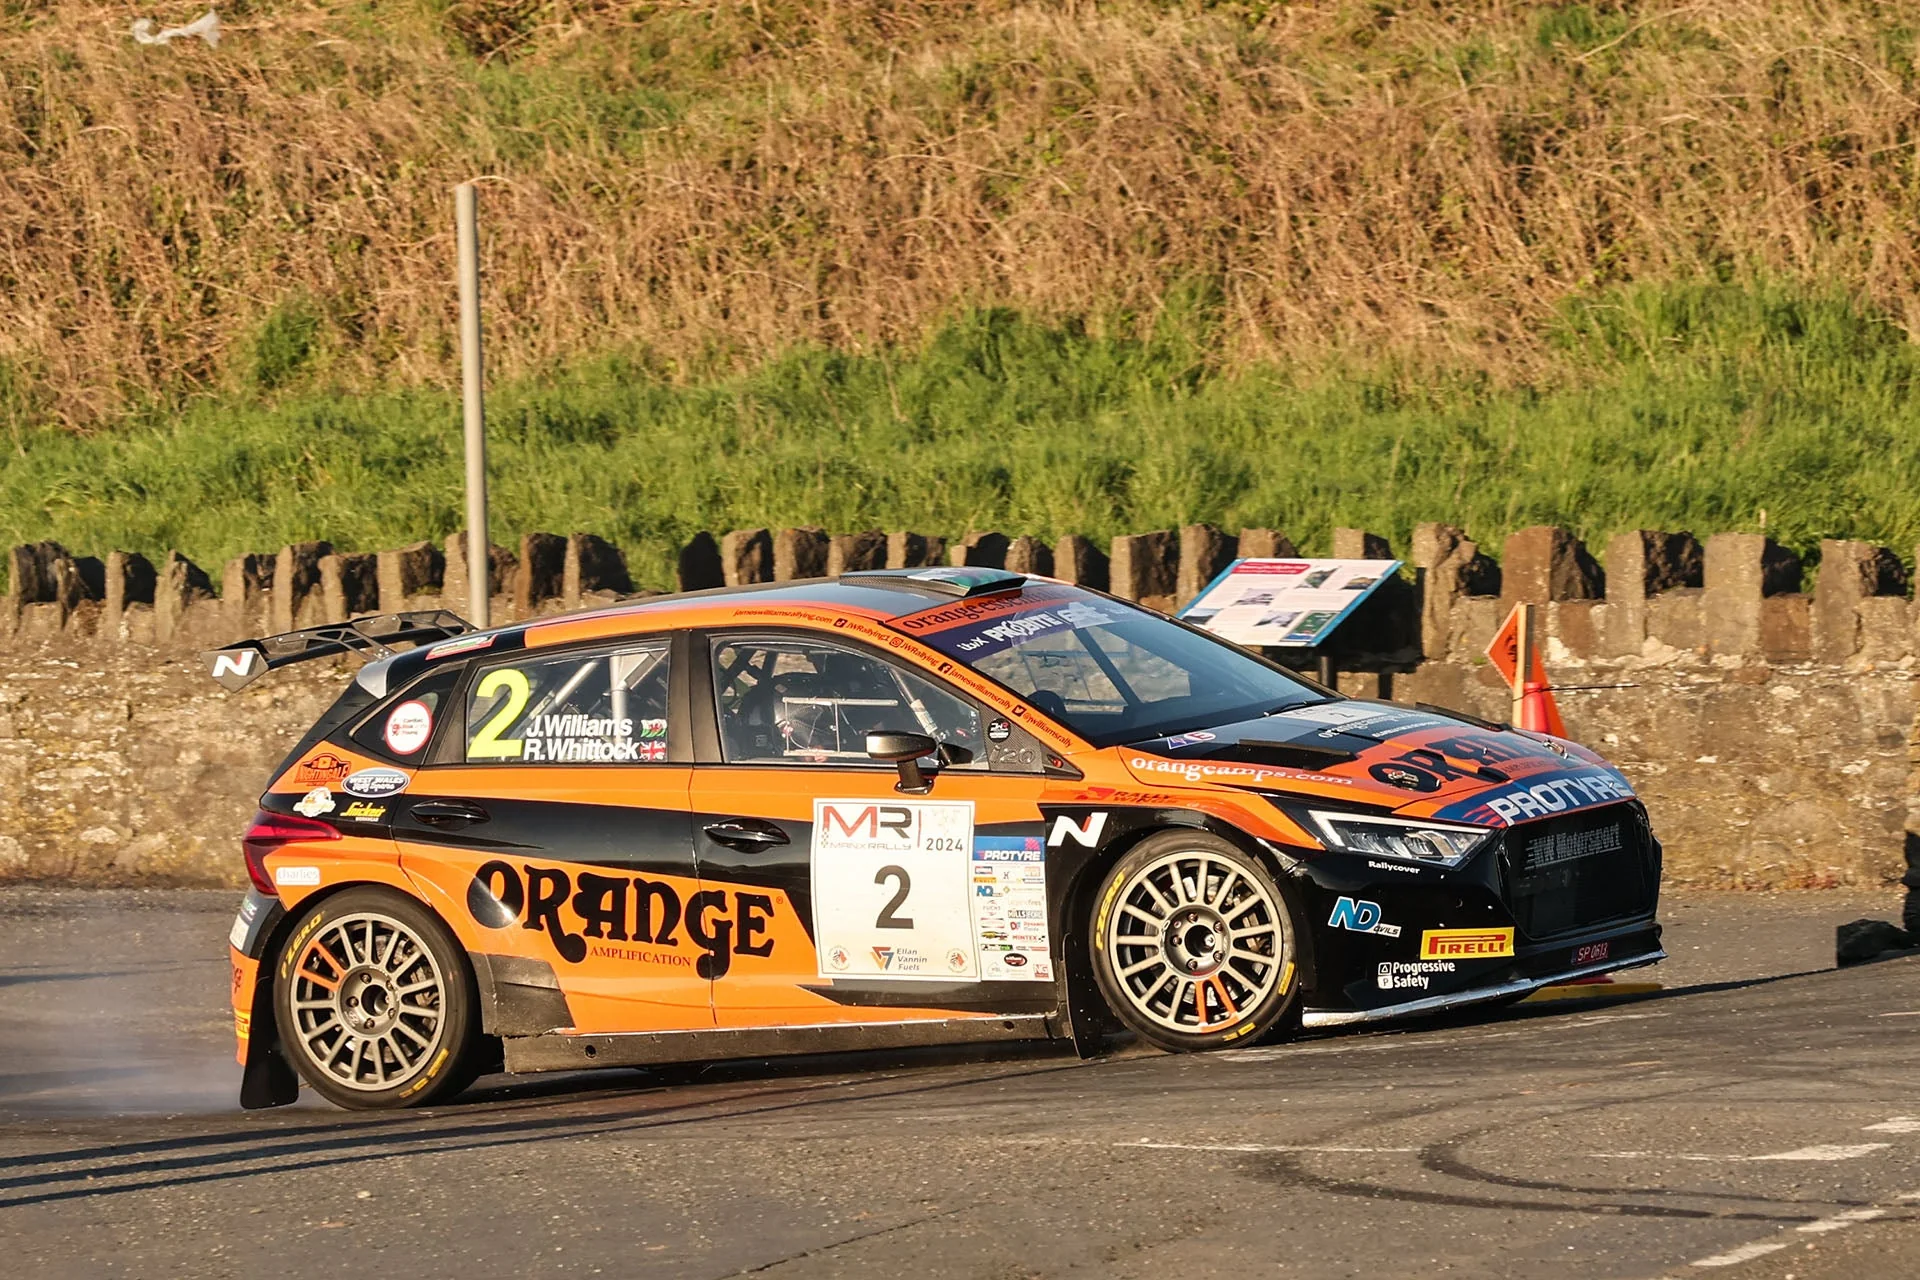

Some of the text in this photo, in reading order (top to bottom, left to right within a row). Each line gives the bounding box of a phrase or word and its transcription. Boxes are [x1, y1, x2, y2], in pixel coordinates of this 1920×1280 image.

[901, 641, 939, 667] JWRallying
[467, 668, 530, 758] 2
[526, 714, 632, 738] J.Williams
[523, 738, 640, 761] R.Whittock
[1487, 774, 1636, 827] PROTYRE
[926, 838, 963, 851] 2024
[983, 850, 1041, 861] PROTYRE
[1368, 860, 1420, 874] Rallycover
[874, 865, 914, 929] 2
[467, 860, 775, 981] ORANGE
[286, 914, 322, 963] ZERO
[1429, 934, 1507, 955] PIRELLI
[590, 945, 691, 968] AMPLIFICATION
[1393, 960, 1456, 975] Progressive
[1394, 975, 1430, 989] Safety
